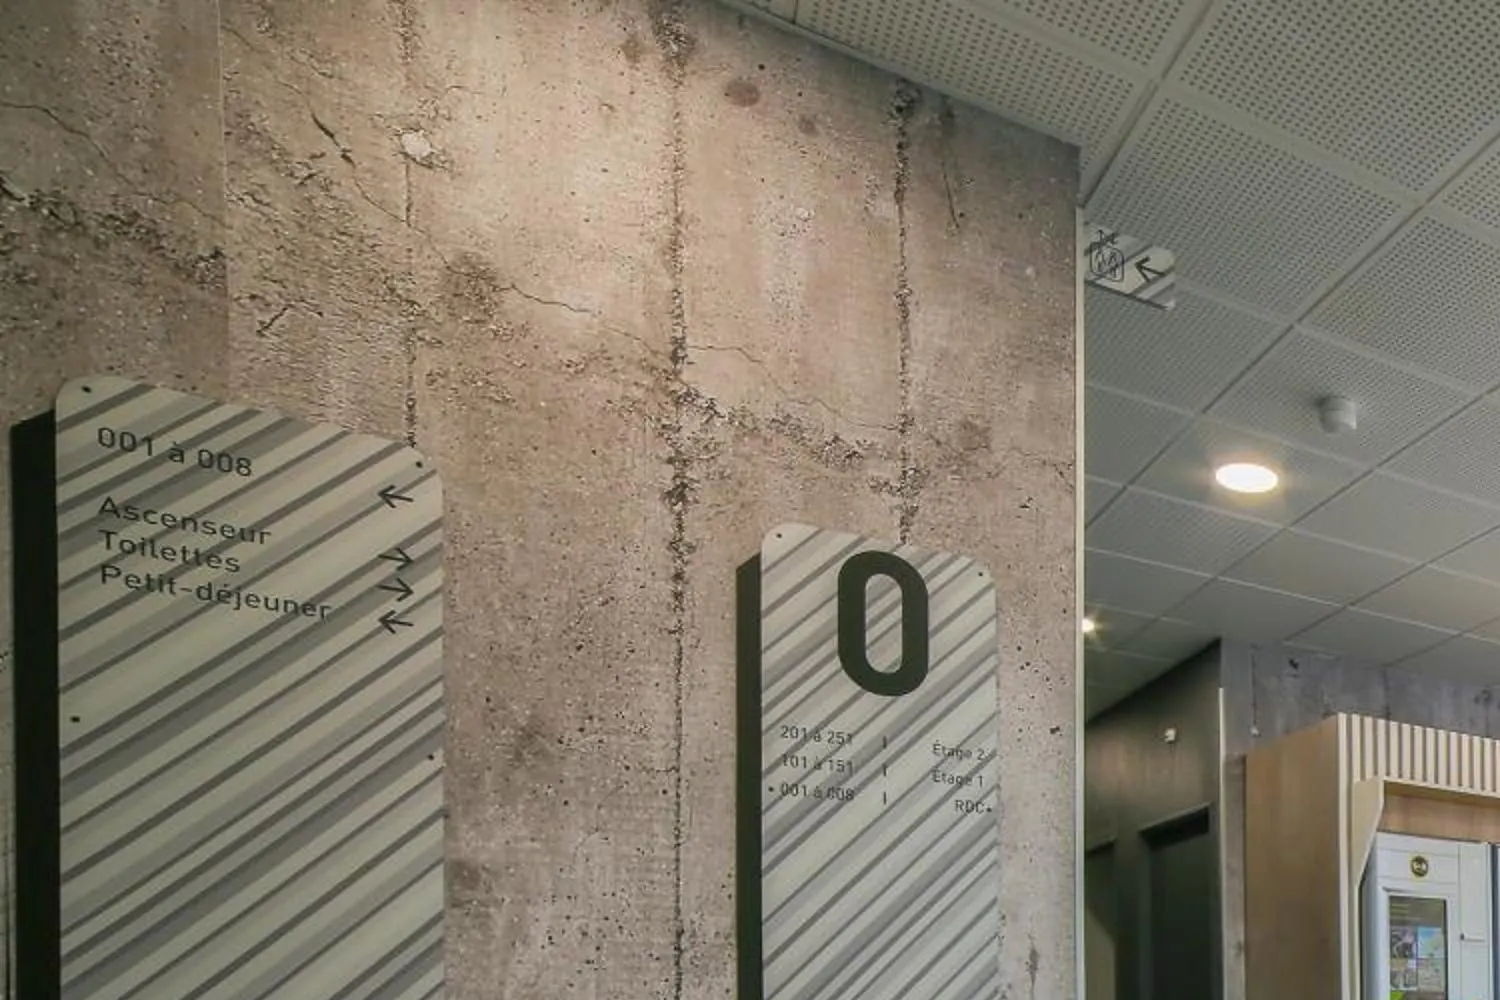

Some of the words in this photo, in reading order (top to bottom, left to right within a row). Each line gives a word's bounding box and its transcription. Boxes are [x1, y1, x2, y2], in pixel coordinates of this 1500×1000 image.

[97, 427, 154, 457] 001
[167, 440, 185, 464] à
[197, 449, 253, 477] 008
[100, 496, 273, 545] Ascenseur
[98, 529, 241, 574] Toilettes
[100, 563, 333, 620] Petit-déjeuner
[837, 550, 929, 697] 0
[781, 725, 808, 741] 201
[781, 782, 808, 797] 001
[954, 799, 986, 815] RDC
